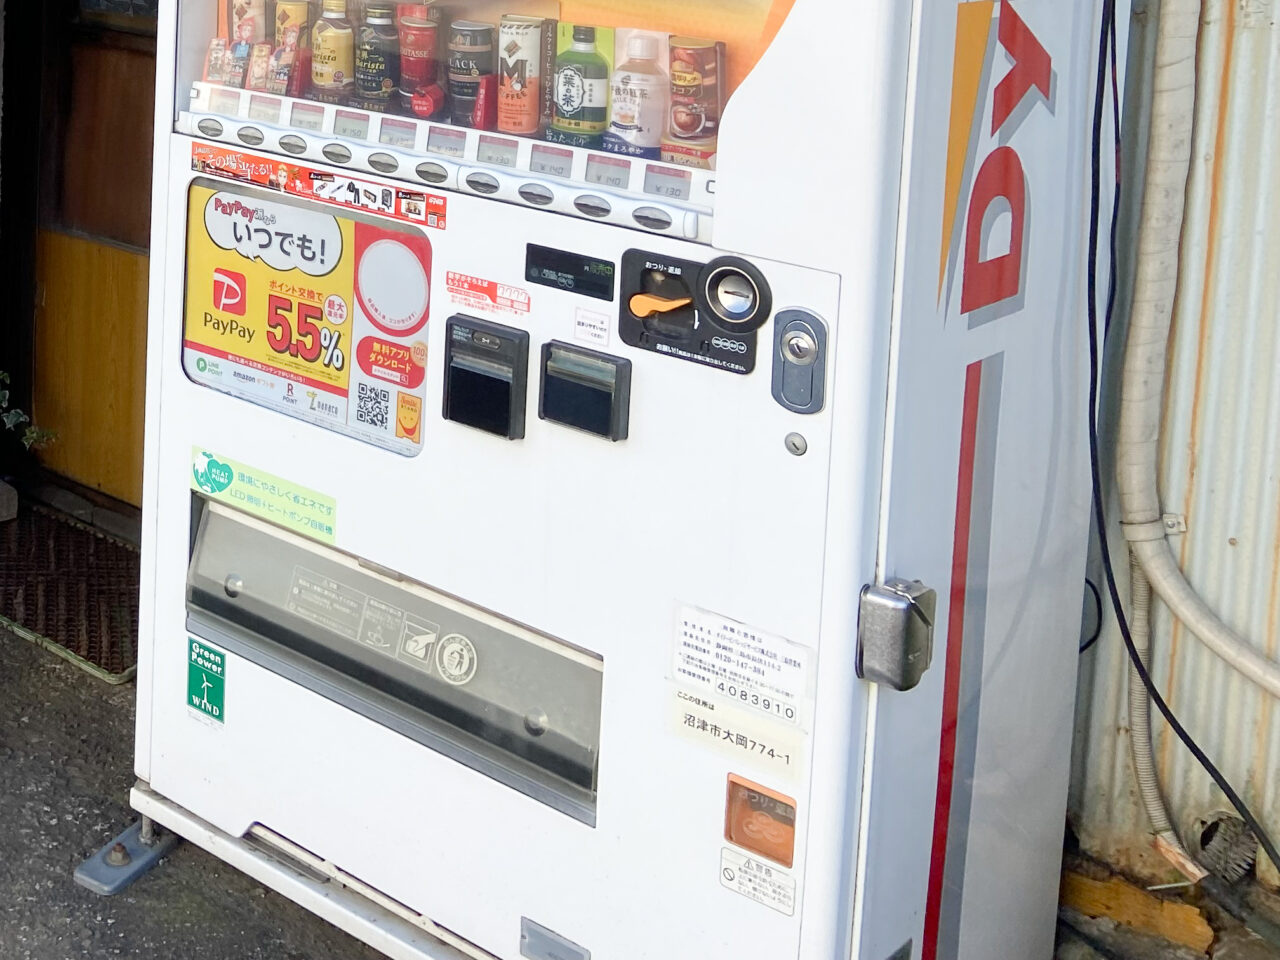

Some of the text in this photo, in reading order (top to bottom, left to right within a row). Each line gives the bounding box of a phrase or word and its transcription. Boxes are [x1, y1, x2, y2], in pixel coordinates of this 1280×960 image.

[561, 73, 576, 109] 葉の茶
[233, 221, 326, 265] いつでも!
[269, 280, 323, 301] ポイント交換で
[327, 299, 345, 312] 最大
[203, 311, 256, 344] PayPay
[266, 294, 345, 371] 5.5%
[372, 341, 410, 361] 無料アプリ
[207, 368, 223, 377] POINT
[369, 353, 412, 374] ダウンロード
[233, 370, 256, 383] amazon
[282, 395, 298, 405] POINT
[191, 651, 223, 674] Power
[192, 642, 222, 664] Green
[191, 694, 220, 716] WIND
[677, 691, 715, 711] ここの住所は
[717, 682, 794, 719] 4083910
[683, 712, 790, 765] 沼津市大岡774-1
